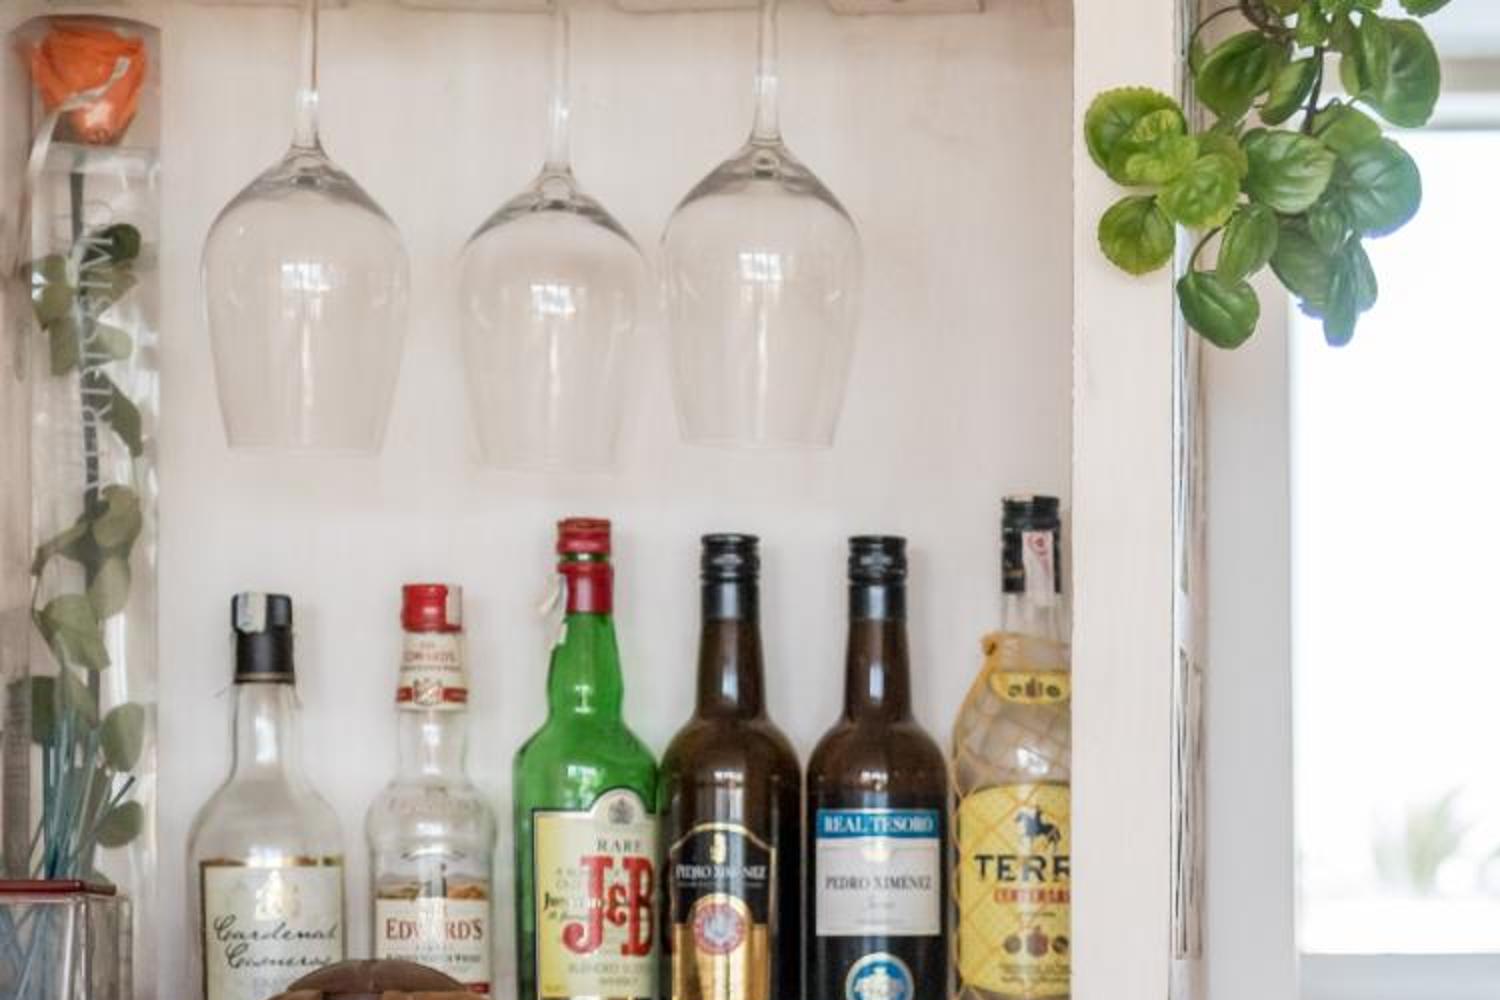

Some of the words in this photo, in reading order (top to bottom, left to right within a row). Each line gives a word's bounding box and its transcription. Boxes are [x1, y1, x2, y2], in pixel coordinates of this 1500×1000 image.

[824, 815, 864, 833] REAL
[869, 815, 933, 833] TESORO
[826, 875, 870, 890] PEDRO
[563, 856, 653, 956] J&B
